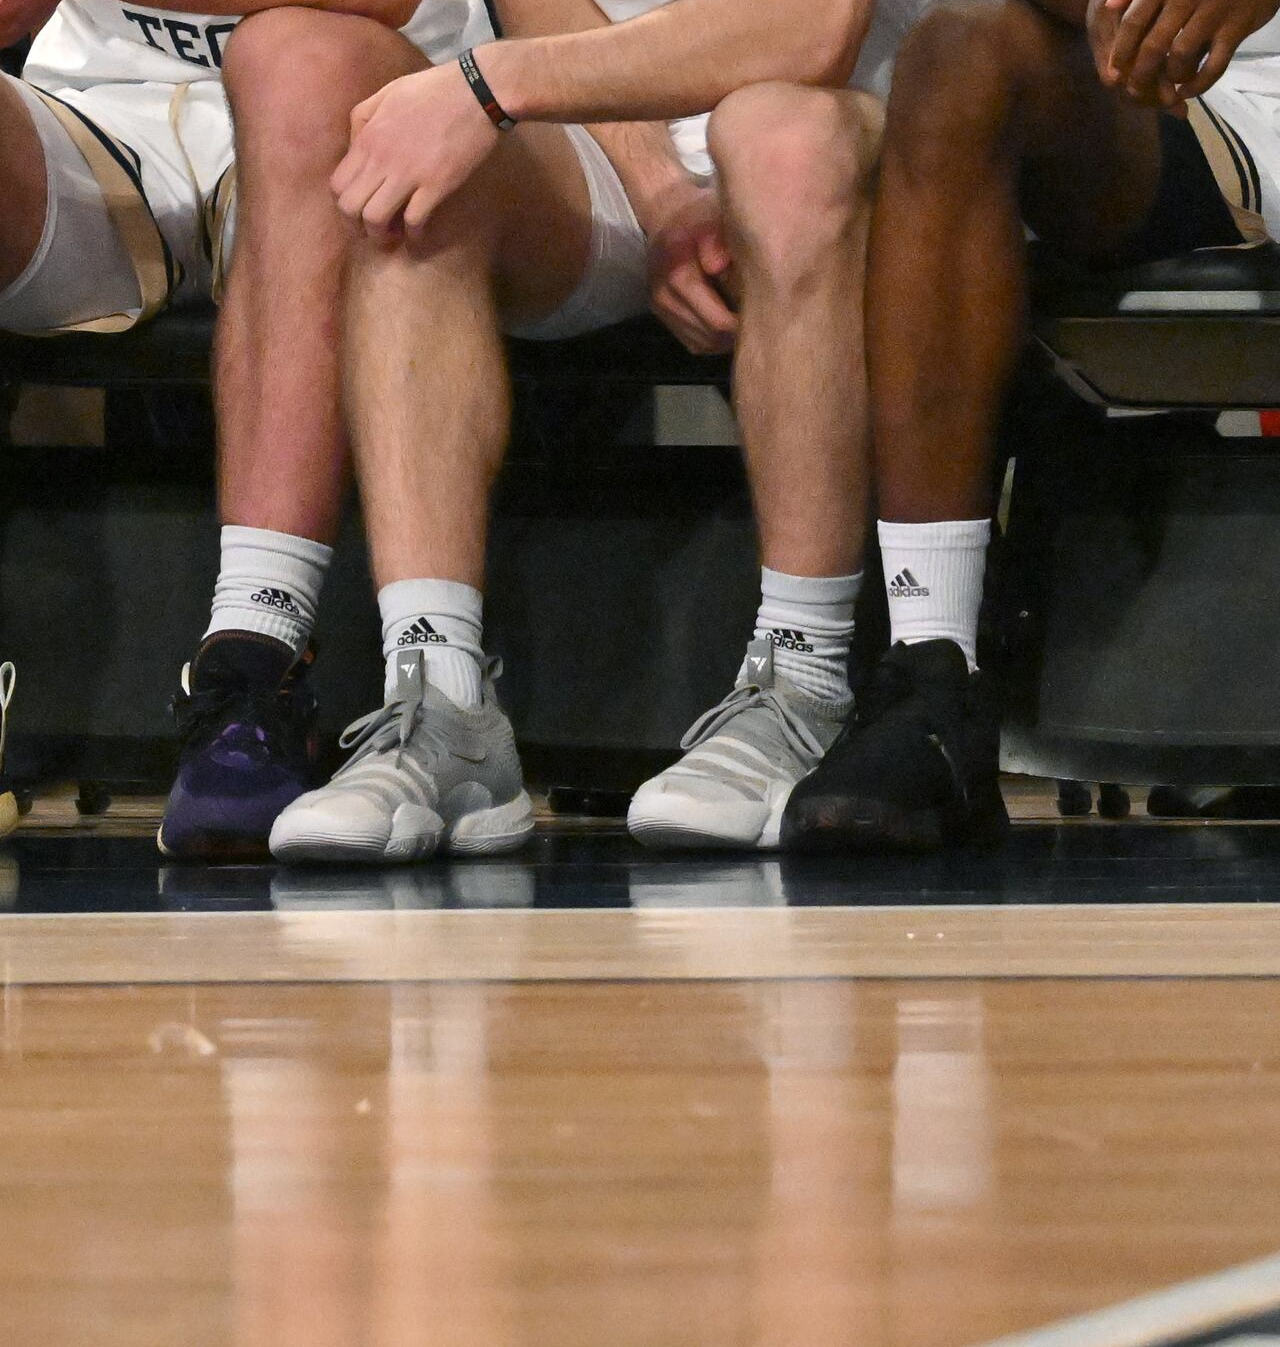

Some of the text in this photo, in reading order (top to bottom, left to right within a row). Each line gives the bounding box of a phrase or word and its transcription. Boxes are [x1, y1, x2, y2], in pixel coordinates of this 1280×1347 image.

[121, 7, 236, 69] TEC
[889, 585, 930, 598] adidas
[249, 591, 300, 615] adidas
[397, 631, 448, 647] adidas
[765, 632, 814, 653] adidas
